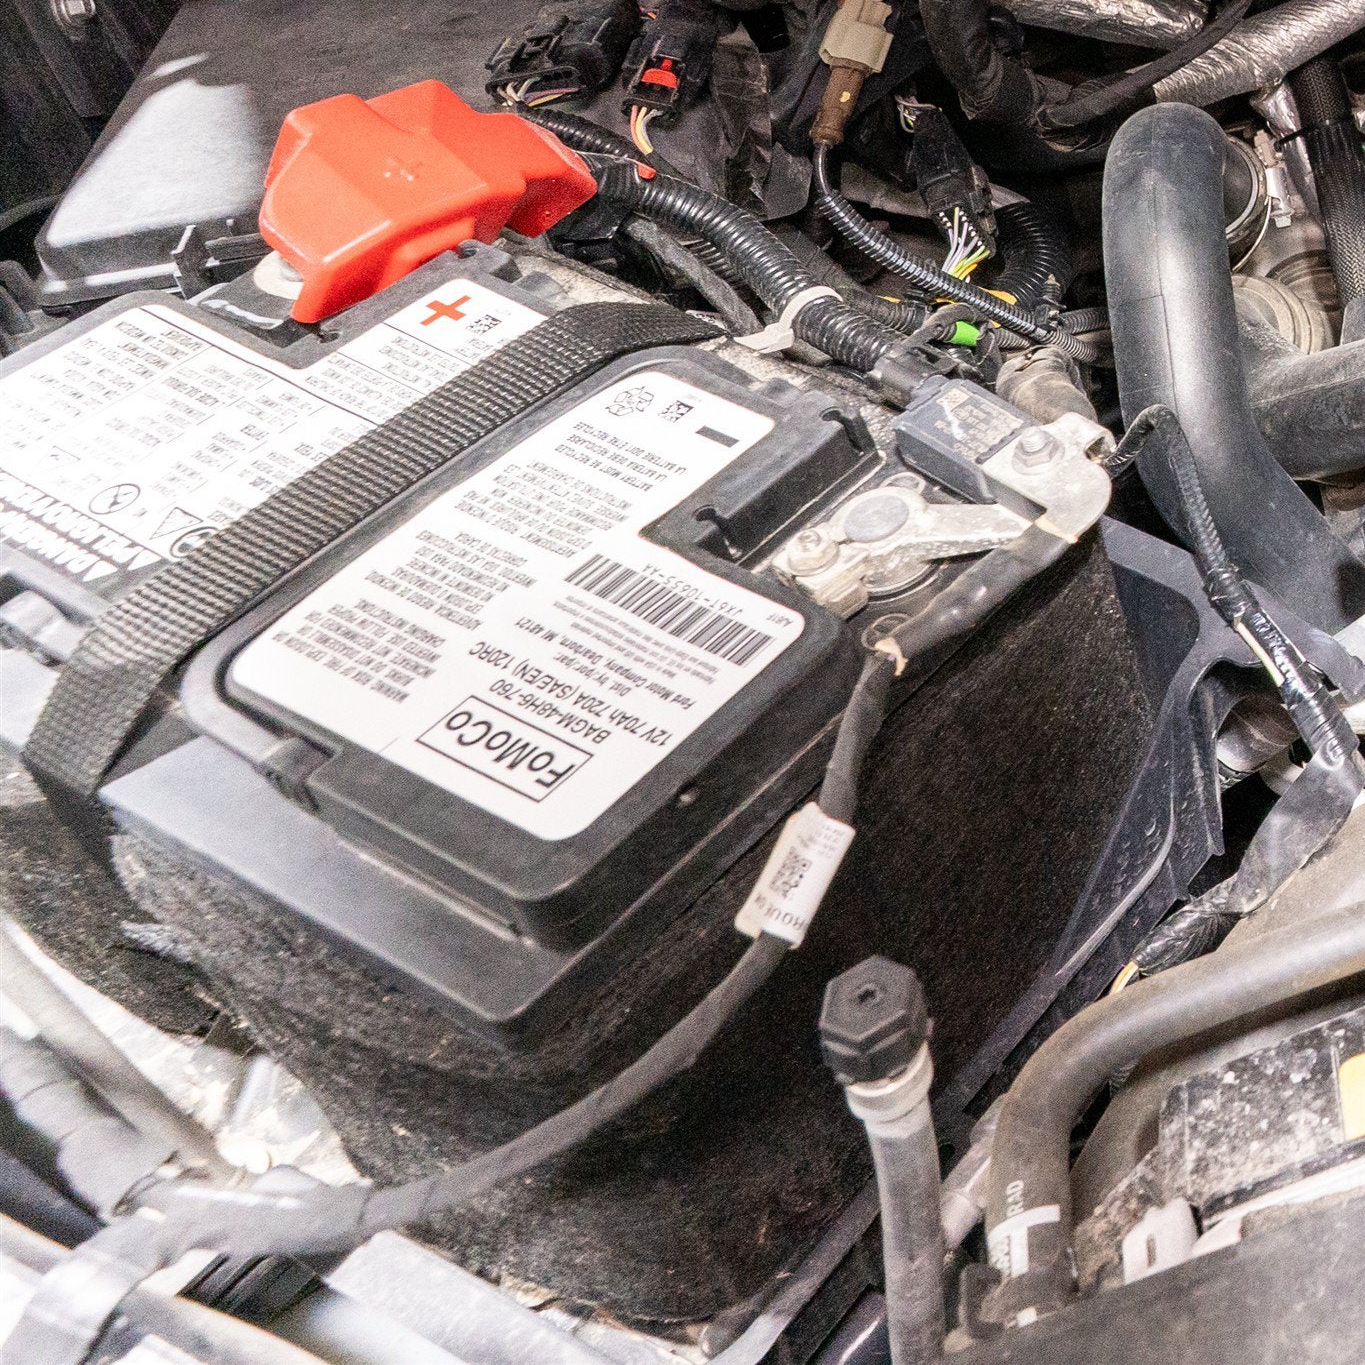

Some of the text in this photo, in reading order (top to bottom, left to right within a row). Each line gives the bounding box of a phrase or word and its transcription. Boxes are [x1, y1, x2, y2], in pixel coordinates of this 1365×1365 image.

[565, 433, 610, 457] RECICLARSE
[624, 444, 645, 456] DOIT
[553, 443, 653, 492] BATTERY MUST BE RECYCLED
[606, 451, 629, 465] DEBE
[641, 451, 676, 471] BATTERIE
[653, 472, 667, 482] LA
[672, 465, 687, 475] LA
[638, 563, 744, 618] JX6T-10655-AA
[513, 616, 546, 635] 48121
[540, 629, 558, 641] MI
[466, 640, 674, 746] 12V 70Ah 720A (SAE/EN) 120RC
[643, 681, 674, 700] Motor
[669, 693, 696, 709] Ford
[486, 678, 612, 744] BAGM-48H6-760
[432, 708, 577, 789] FoMoCo
[1005, 1179, 1026, 1218] RAD
